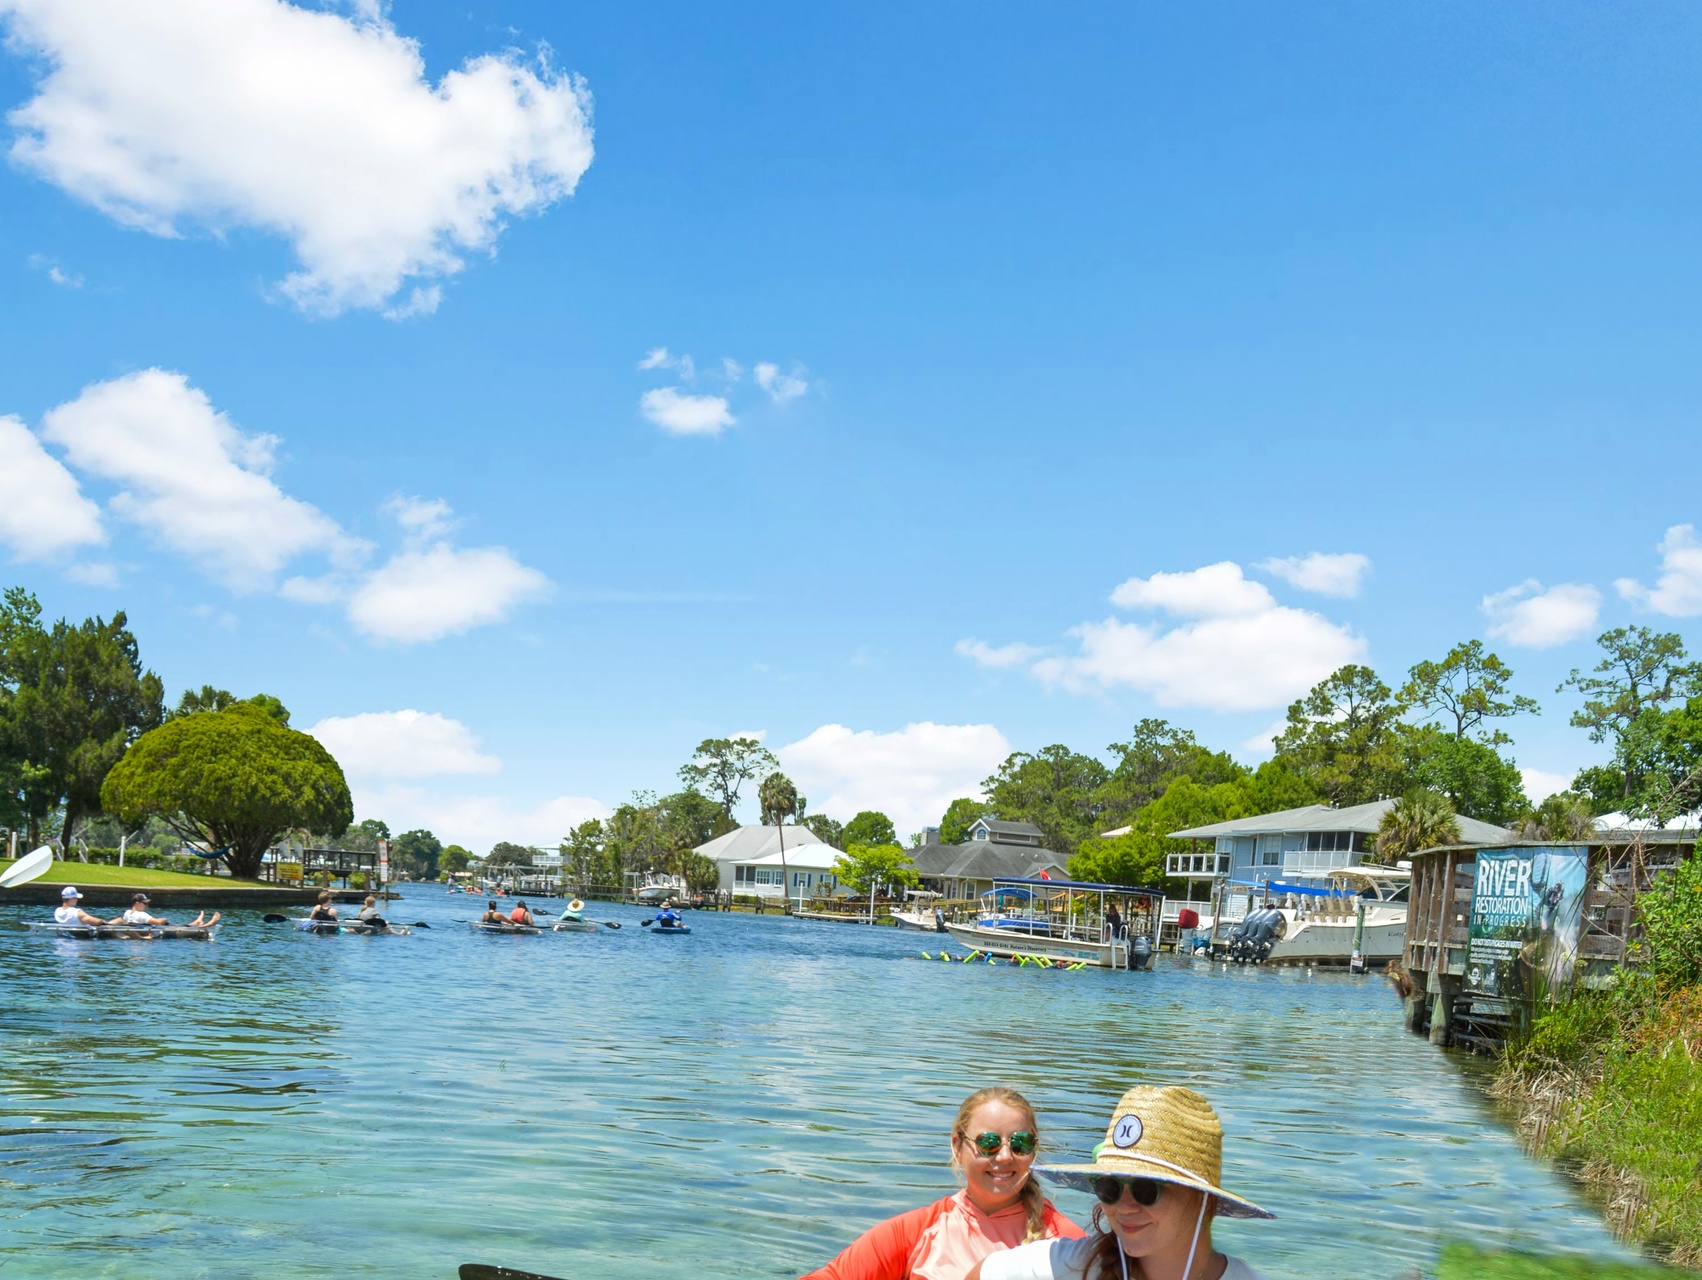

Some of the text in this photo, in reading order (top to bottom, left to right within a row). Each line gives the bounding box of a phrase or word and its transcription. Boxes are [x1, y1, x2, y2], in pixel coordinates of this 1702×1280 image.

[1477, 860, 1532, 896] RIVER
[1475, 896, 1529, 915] RESTORATION
[1473, 915, 1527, 927] IN PROGRESS
